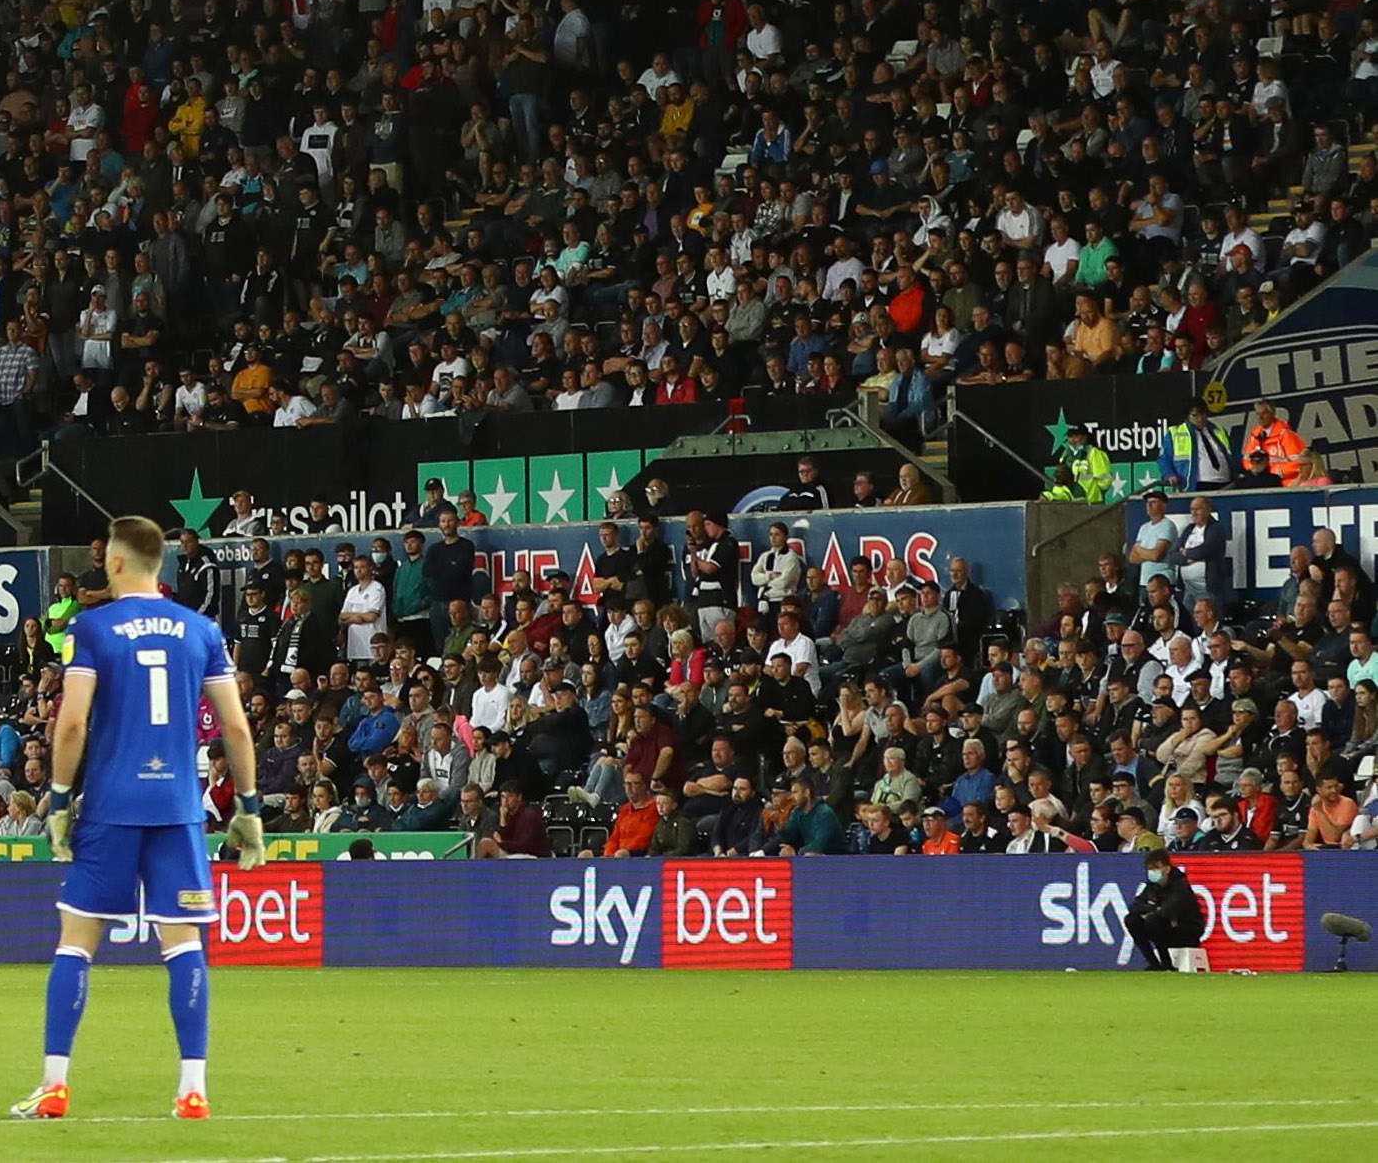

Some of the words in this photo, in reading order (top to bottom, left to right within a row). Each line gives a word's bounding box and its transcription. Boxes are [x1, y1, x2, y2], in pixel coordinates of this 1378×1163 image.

[1207, 390, 1222, 404] 57
[1246, 340, 1378, 395] THE
[1084, 418, 1167, 457] Trustpil
[229, 490, 406, 535] ruspilot
[790, 532, 939, 610] ARS
[136, 649, 168, 725] 1
[220, 872, 310, 943] bet
[549, 866, 652, 965] sky
[676, 870, 778, 944] bet
[1039, 862, 1145, 965] sky
